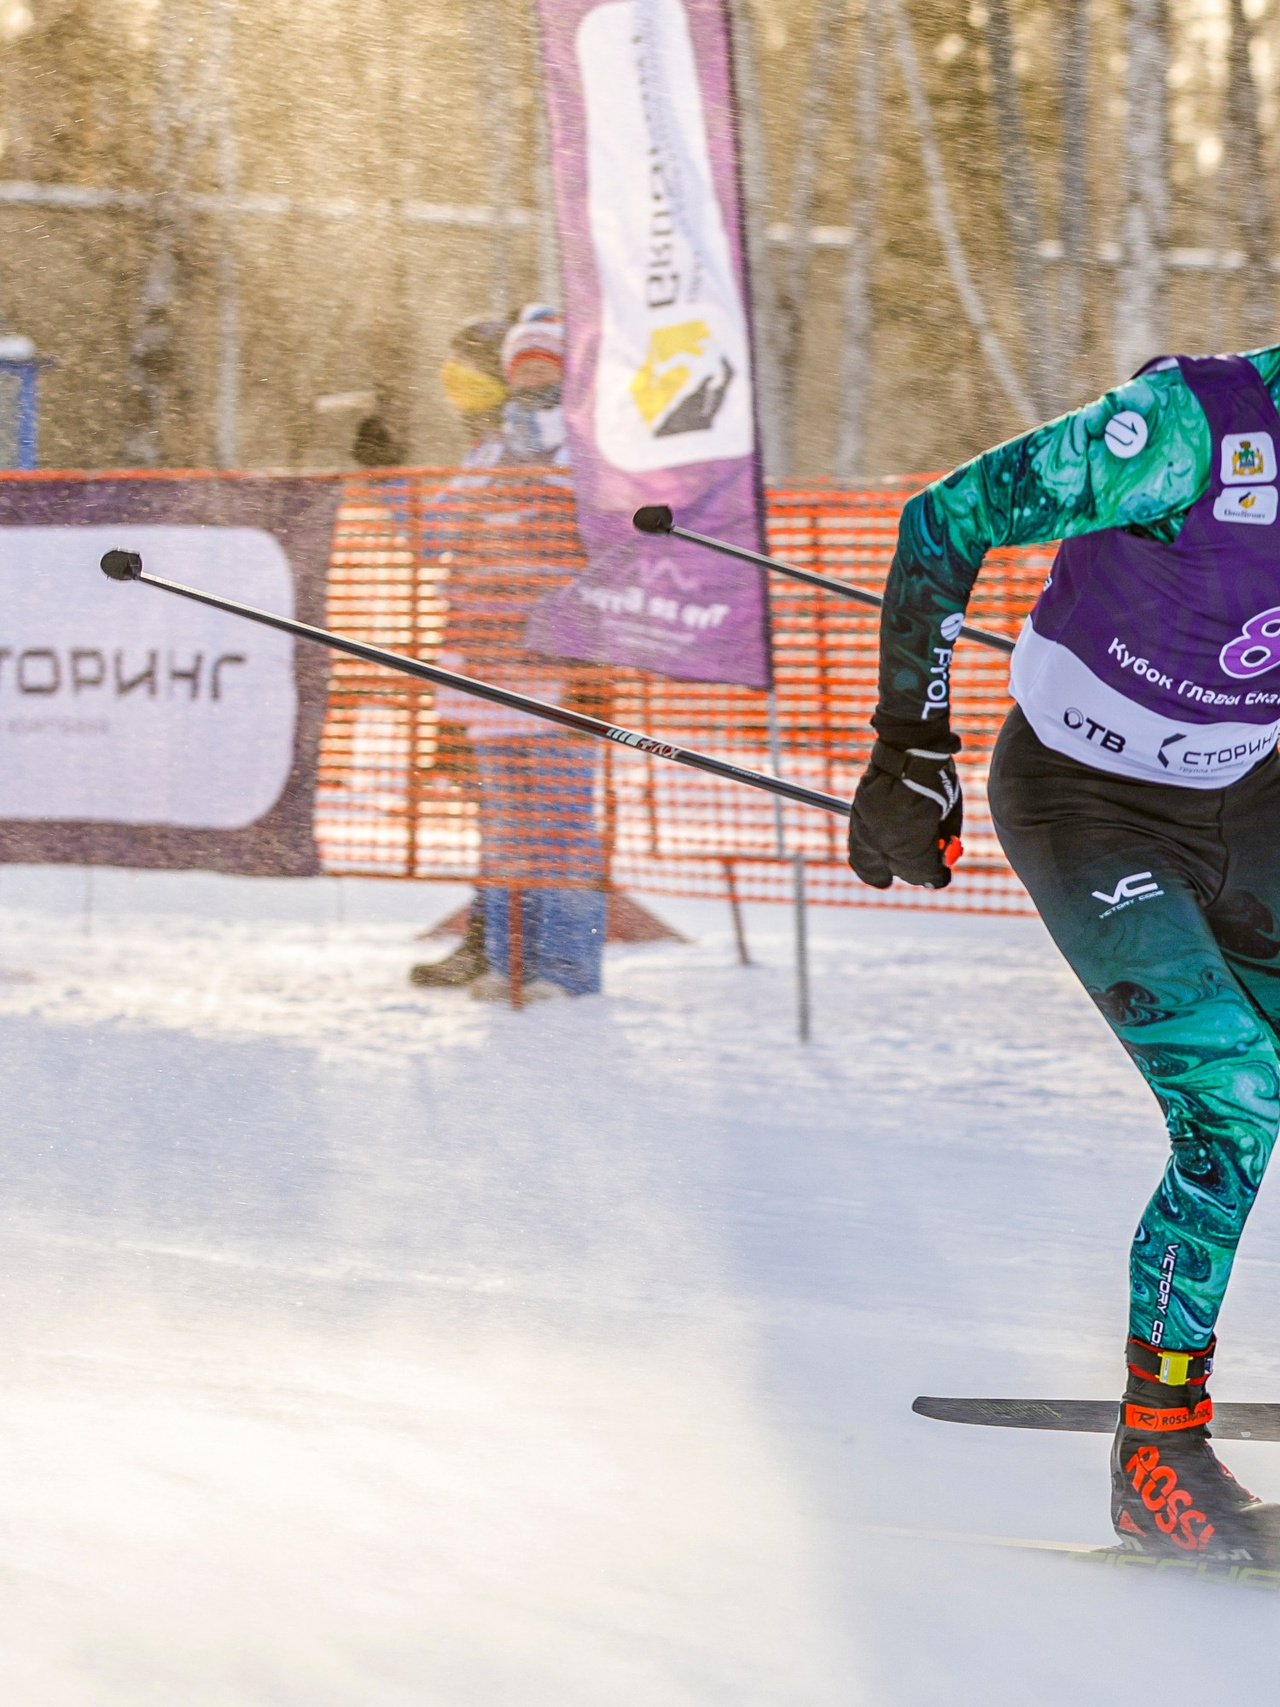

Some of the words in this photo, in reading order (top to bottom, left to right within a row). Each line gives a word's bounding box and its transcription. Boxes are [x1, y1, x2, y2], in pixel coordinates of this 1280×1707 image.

[0, 647, 247, 701] ОРИНГ
[1108, 637, 1174, 690] Кубок
[1177, 680, 1240, 706] Главы
[1063, 707, 1127, 754] ОТВ
[1156, 1243, 1180, 1316] VICTORY
[1150, 1319, 1164, 1348] CO
